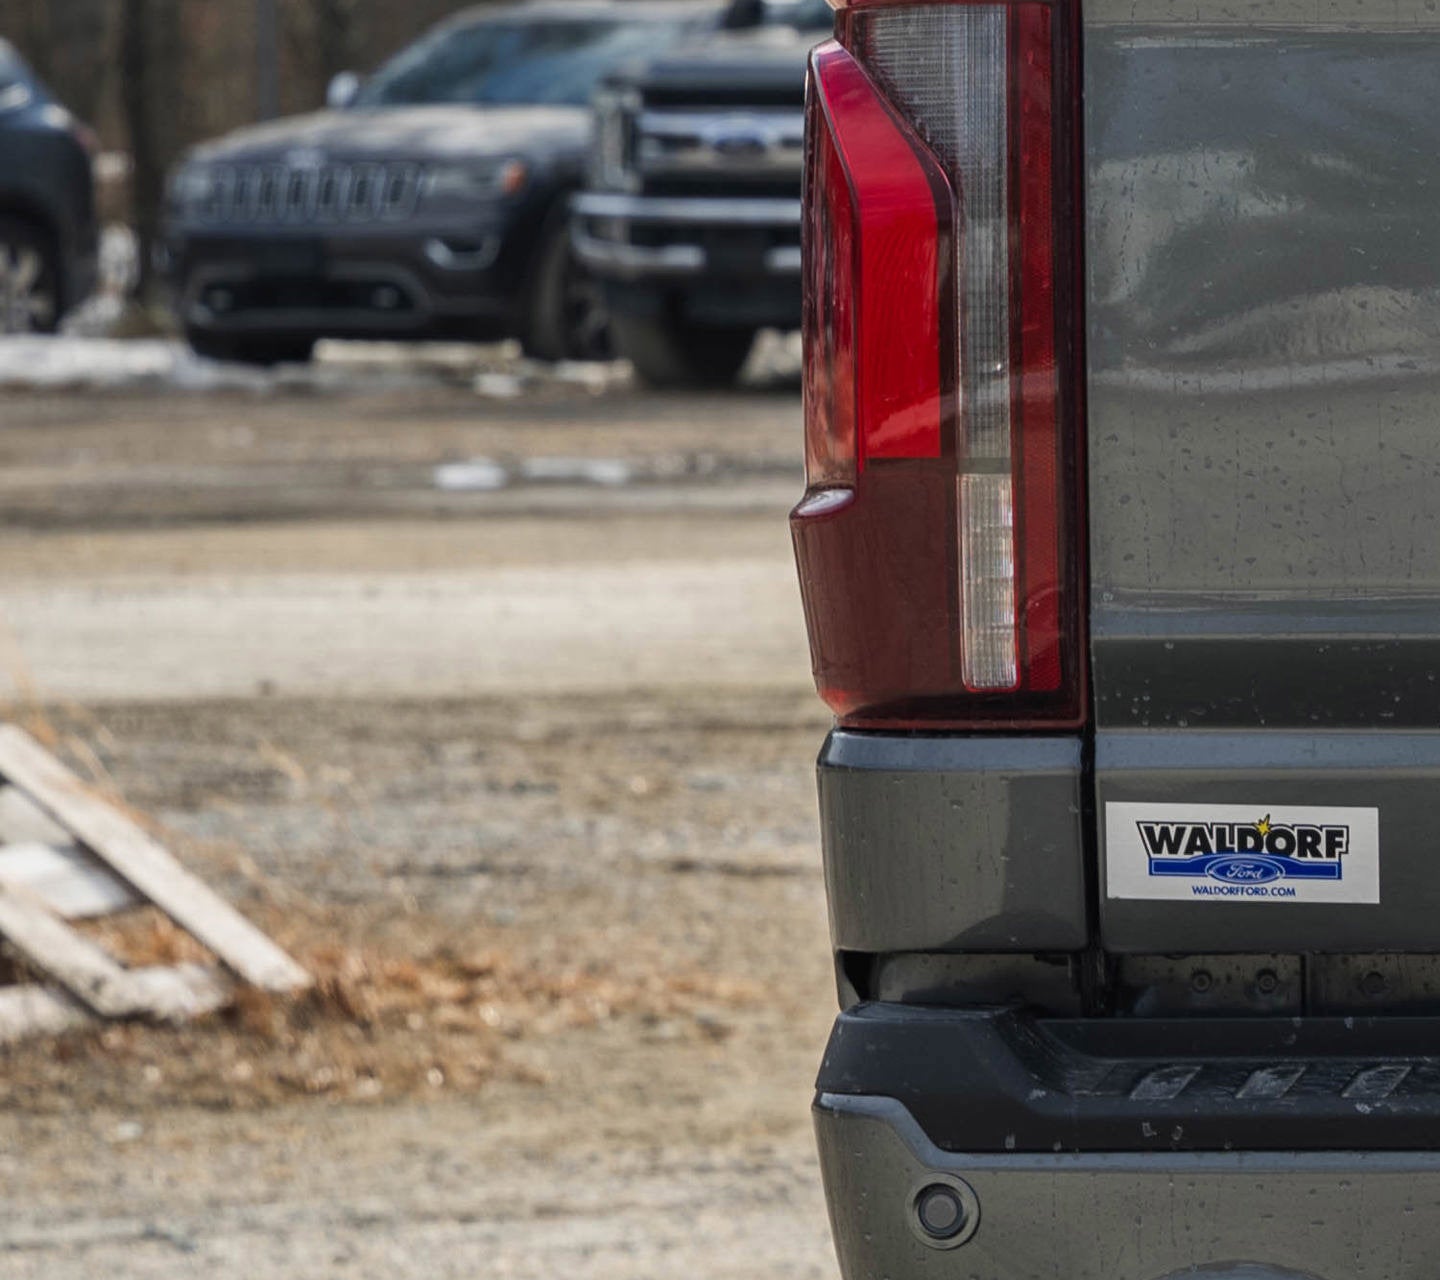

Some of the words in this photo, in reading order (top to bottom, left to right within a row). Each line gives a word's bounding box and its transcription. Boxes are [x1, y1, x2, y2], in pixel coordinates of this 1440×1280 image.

[1143, 824, 1346, 858] WALDORF
[1226, 864, 1264, 880] Ford
[1192, 885, 1296, 897] WALDORFFORD.COM
